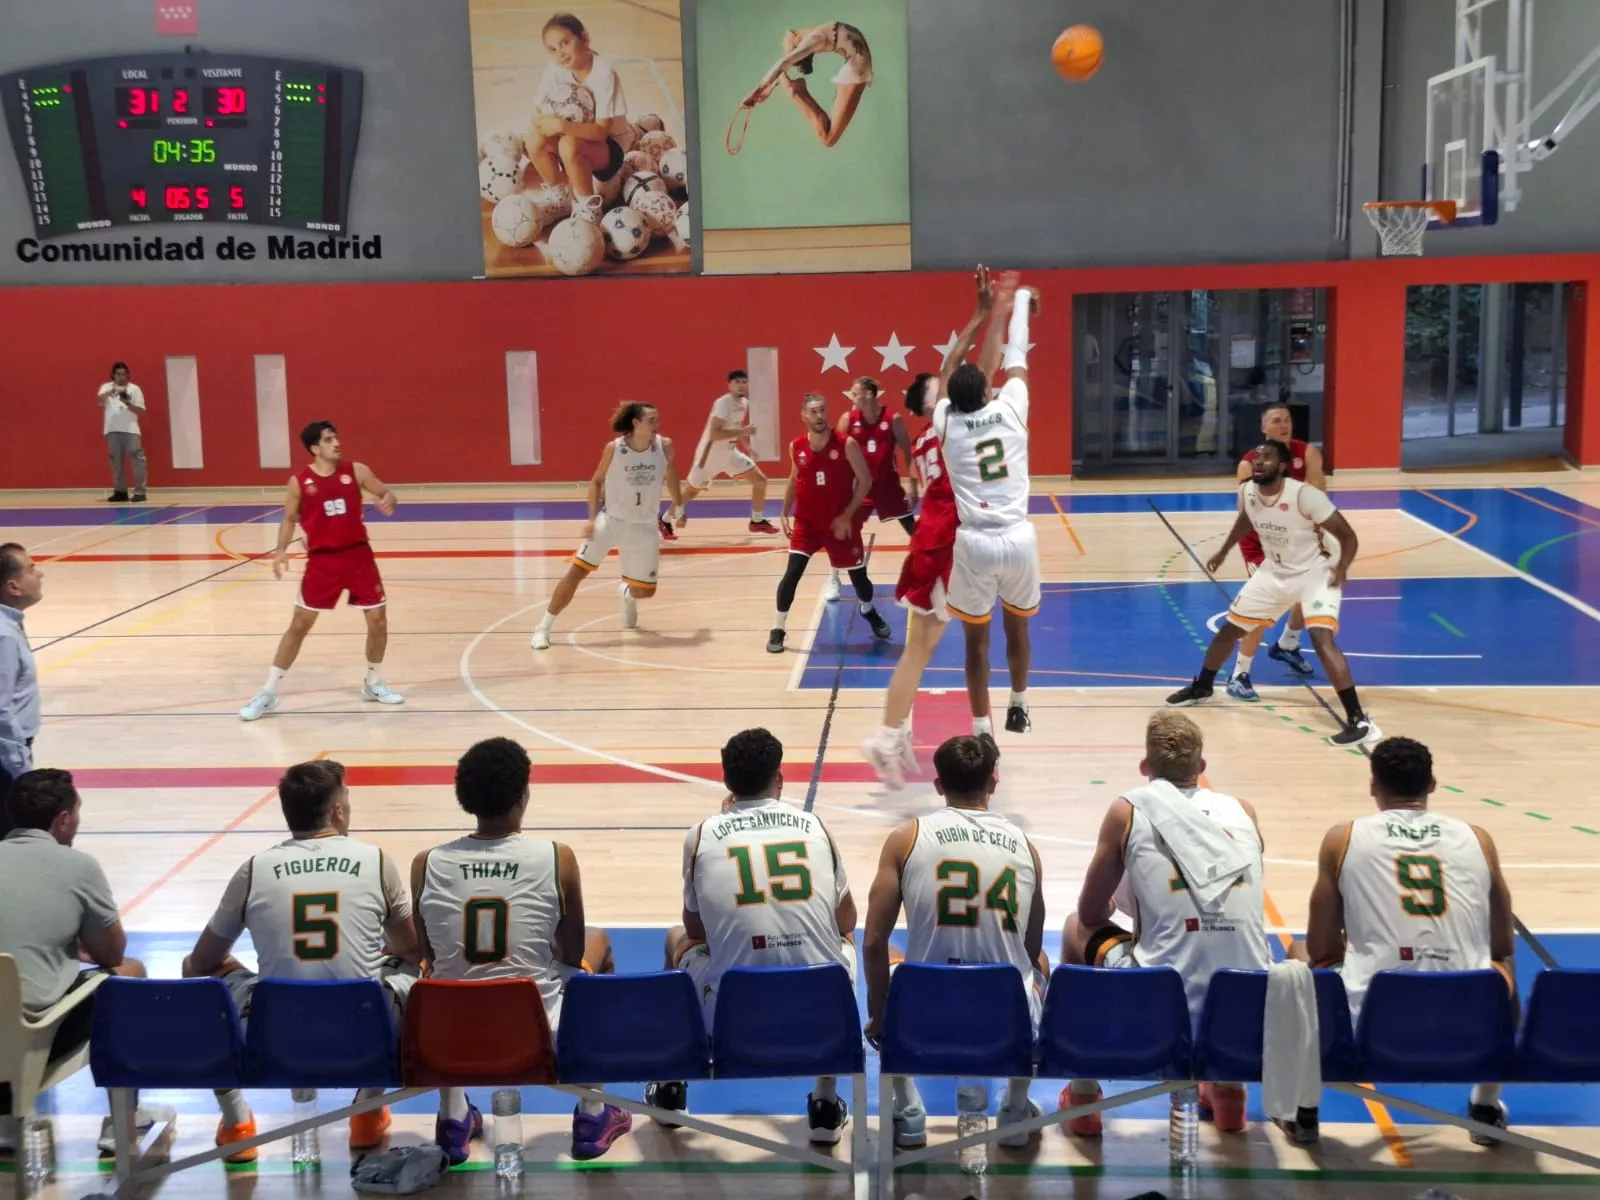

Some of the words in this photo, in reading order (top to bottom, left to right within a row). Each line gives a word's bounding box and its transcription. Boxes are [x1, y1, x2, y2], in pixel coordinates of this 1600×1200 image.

[122, 70, 148, 79] LOCAL
[202, 68, 243, 78] VISITANTE
[275, 82, 282, 92] 4
[129, 87, 159, 115] 31
[173, 89, 189, 113] 2
[217, 87, 246, 115] 30
[274, 94, 281, 104] 5
[274, 105, 281, 115] 6
[274, 117, 281, 127] 7
[273, 128, 280, 138] 8
[273, 139, 280, 149] 9
[153, 139, 216, 163] 04:35
[270, 150, 283, 161] 10
[29, 158, 42, 169] 10
[223, 163, 258, 171] MONDO
[270, 162, 282, 172] 11
[31, 170, 43, 180] 11
[270, 173, 282, 183] 12
[32, 181, 45, 191] 12
[269, 185, 282, 195] 13
[34, 192, 47, 202] 13
[131, 188, 147, 208] 4
[229, 186, 244, 208] 5
[269, 196, 281, 206] 14
[36, 204, 48, 214] 14
[269, 207, 281, 217] 15
[38, 215, 50, 225] 15
[77, 220, 111, 229] MONDO
[306, 222, 341, 231] MONDO
[16, 236, 205, 263] Comunidad
[216, 235, 257, 261] de
[267, 234, 382, 261] Madrid
[964, 412, 1003, 432] WELLS
[974, 437, 1009, 482] 2
[635, 492, 641, 505] 1
[712, 811, 812, 841] LÓPEZ-SANVICENTE
[935, 824, 970, 846] RUBÍN
[972, 828, 986, 844] DE
[989, 831, 1018, 854] CELIS
[273, 857, 362, 880] FIGUEROA
[459, 862, 519, 880] THIAM
[727, 840, 814, 907] 15
[1393, 853, 1449, 920] 9
[935, 858, 1019, 934] 24
[291, 891, 341, 962] 5
[463, 895, 510, 964] 0
[777, 940, 802, 949] Huesca
